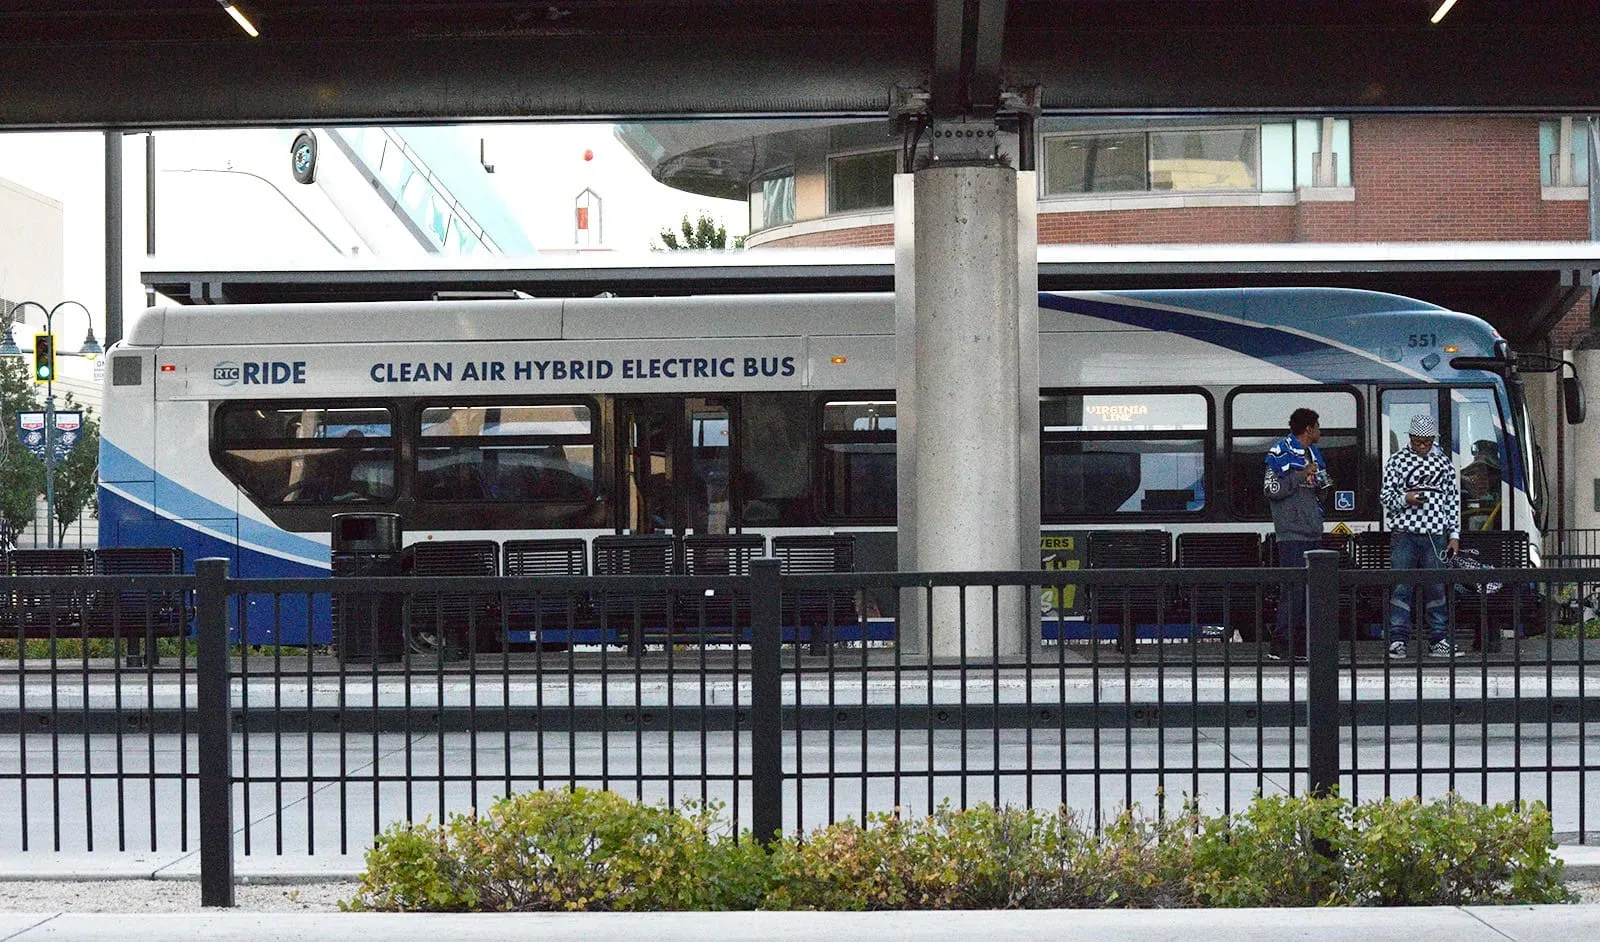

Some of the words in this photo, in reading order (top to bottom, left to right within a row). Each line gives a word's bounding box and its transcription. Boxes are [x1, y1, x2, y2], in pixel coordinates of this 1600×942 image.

[1407, 333, 1437, 348] 551
[214, 367, 240, 380] RTC
[243, 361, 306, 384] RIDE
[370, 362, 453, 383] CLEAN
[460, 361, 506, 381] AIR
[514, 359, 614, 381] HYBRID
[622, 358, 735, 379] ELECTRIC
[743, 356, 796, 377] BUS
[1086, 405, 1148, 414] VIRGINIA
[1102, 413, 1133, 421] LINE
